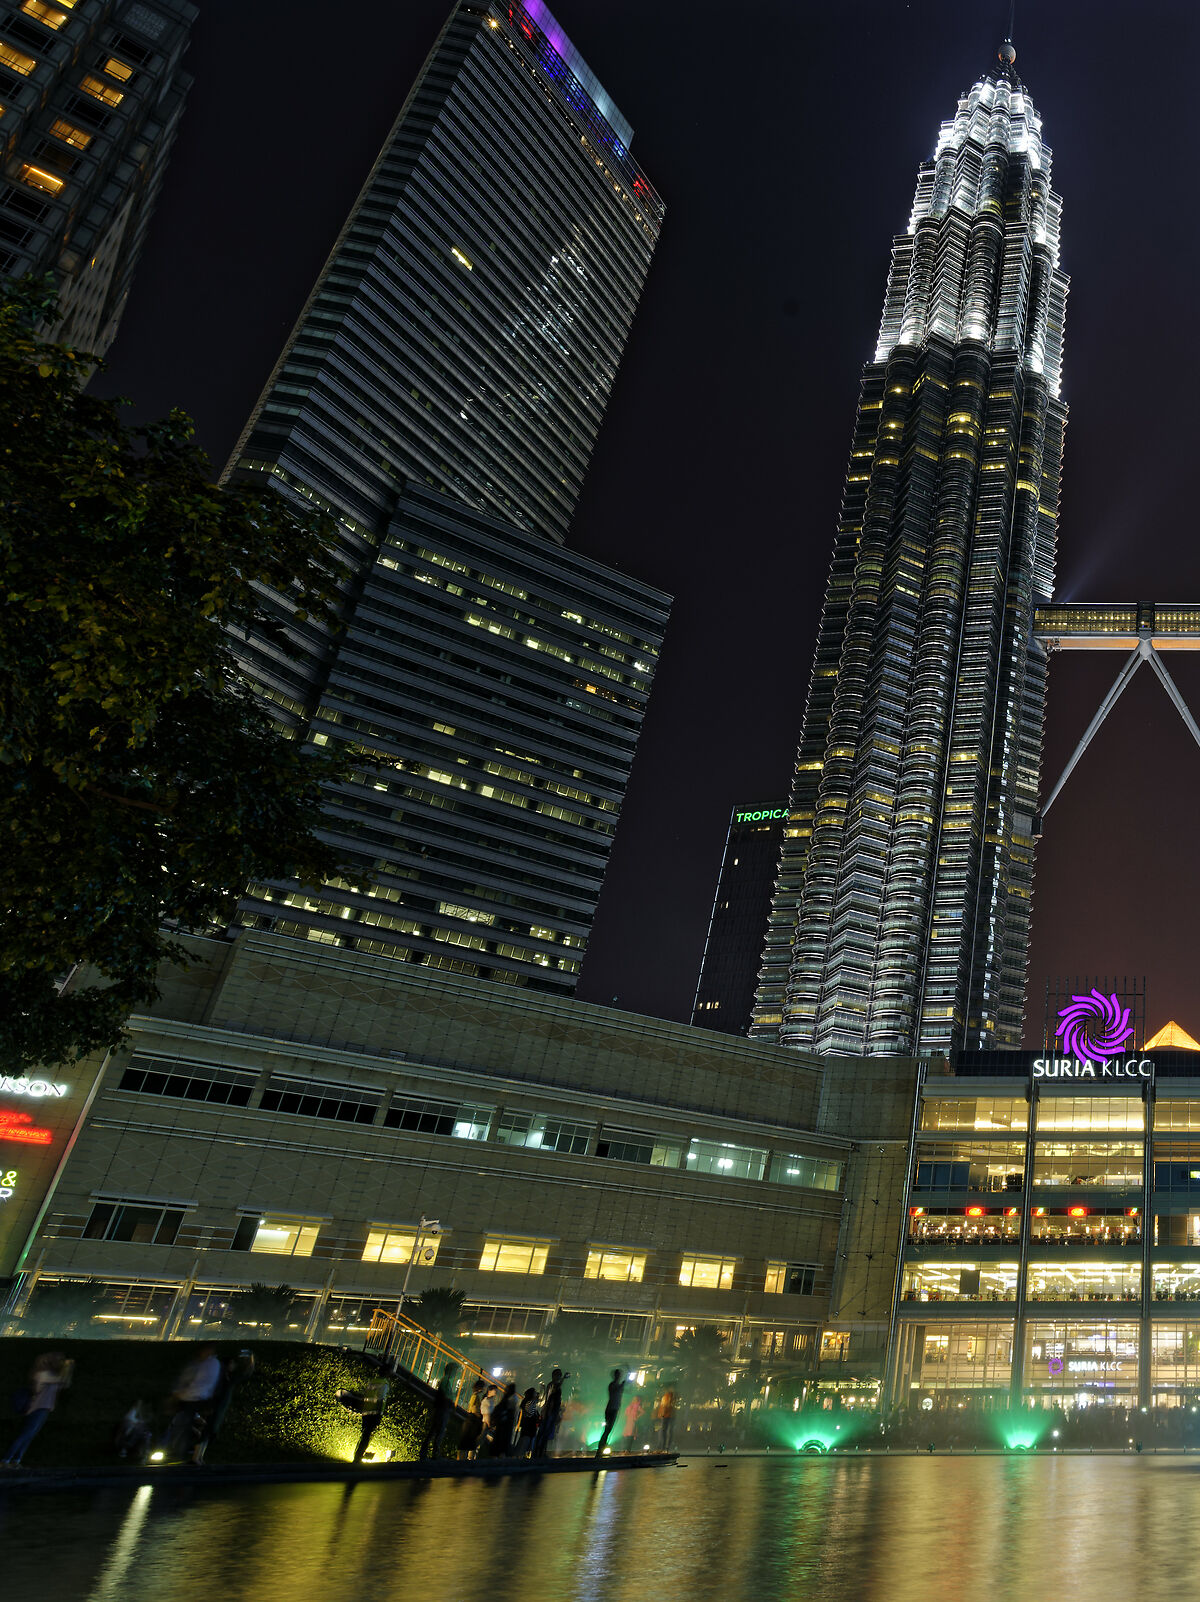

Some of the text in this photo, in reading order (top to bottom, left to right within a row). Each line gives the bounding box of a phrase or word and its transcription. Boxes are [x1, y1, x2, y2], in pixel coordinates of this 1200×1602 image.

[736, 808, 790, 822] TROPICA
[1033, 1059, 1152, 1077] SURIA KLCC
[1068, 1361, 1122, 1371] SURIA KLCC
